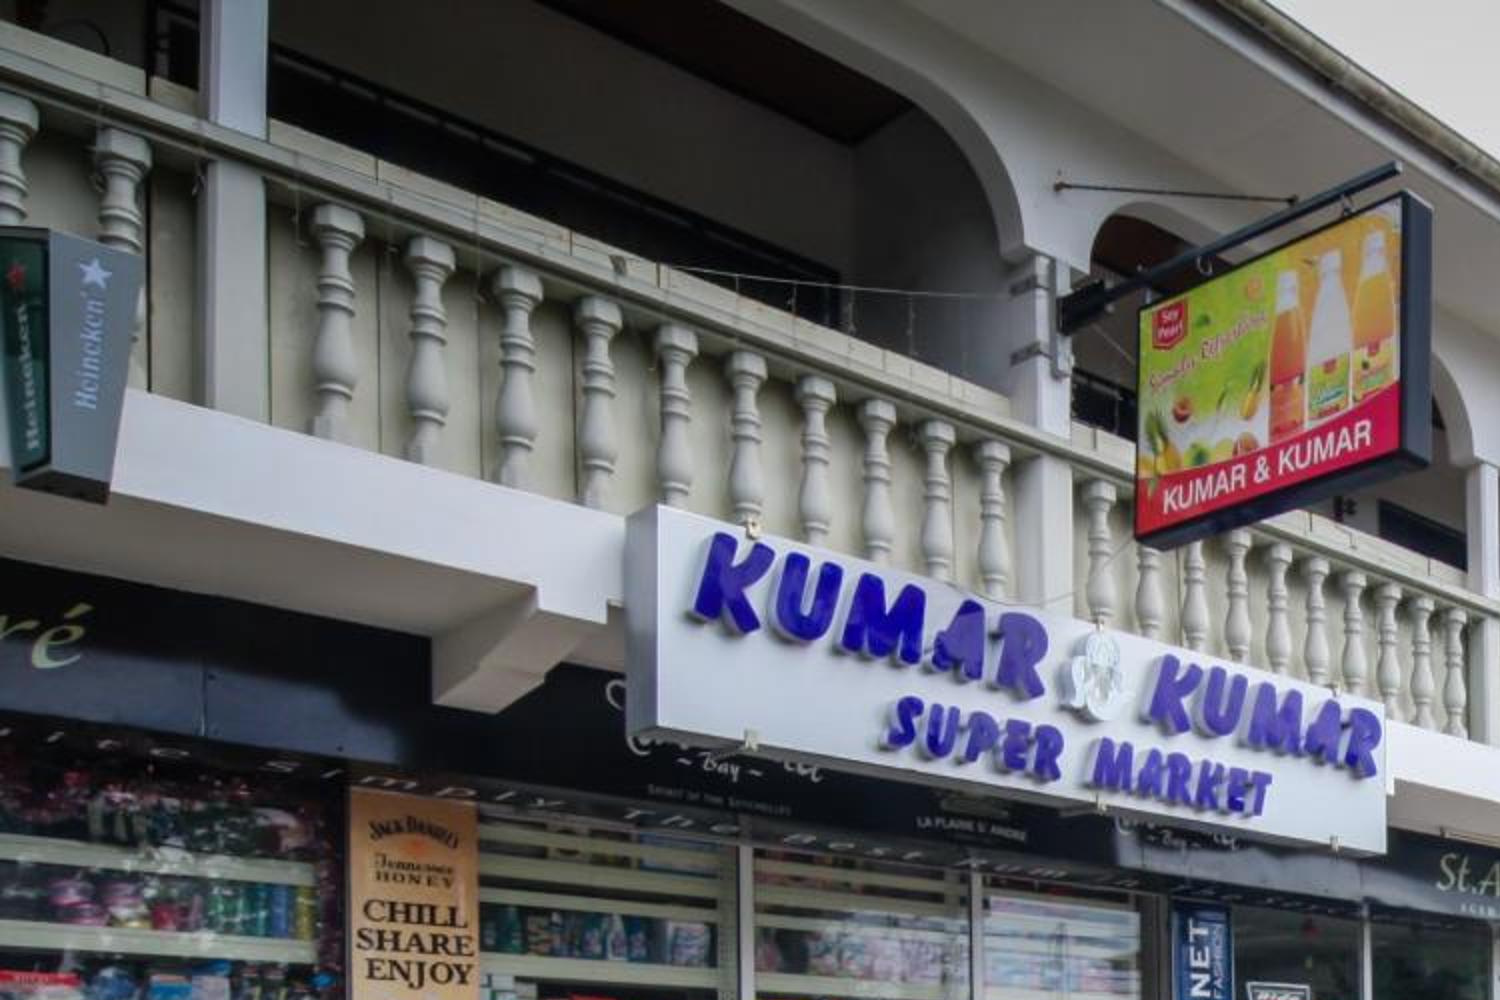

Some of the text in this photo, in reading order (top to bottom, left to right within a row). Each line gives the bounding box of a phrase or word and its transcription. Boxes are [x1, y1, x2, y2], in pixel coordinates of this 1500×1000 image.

[15, 303, 40, 452] Heineken
[74, 300, 106, 410] Heineken
[1162, 420, 1372, 514] KUMAR & KUMAR
[691, 531, 1384, 779] KUMAR KUMAR
[880, 695, 1273, 820] SUPER MARKET
[367, 819, 402, 842] JACK
[376, 870, 454, 889] HONEY
[356, 928, 474, 957] SHARE
[362, 899, 468, 928] CHILL
[365, 957, 474, 990] ENJOY
